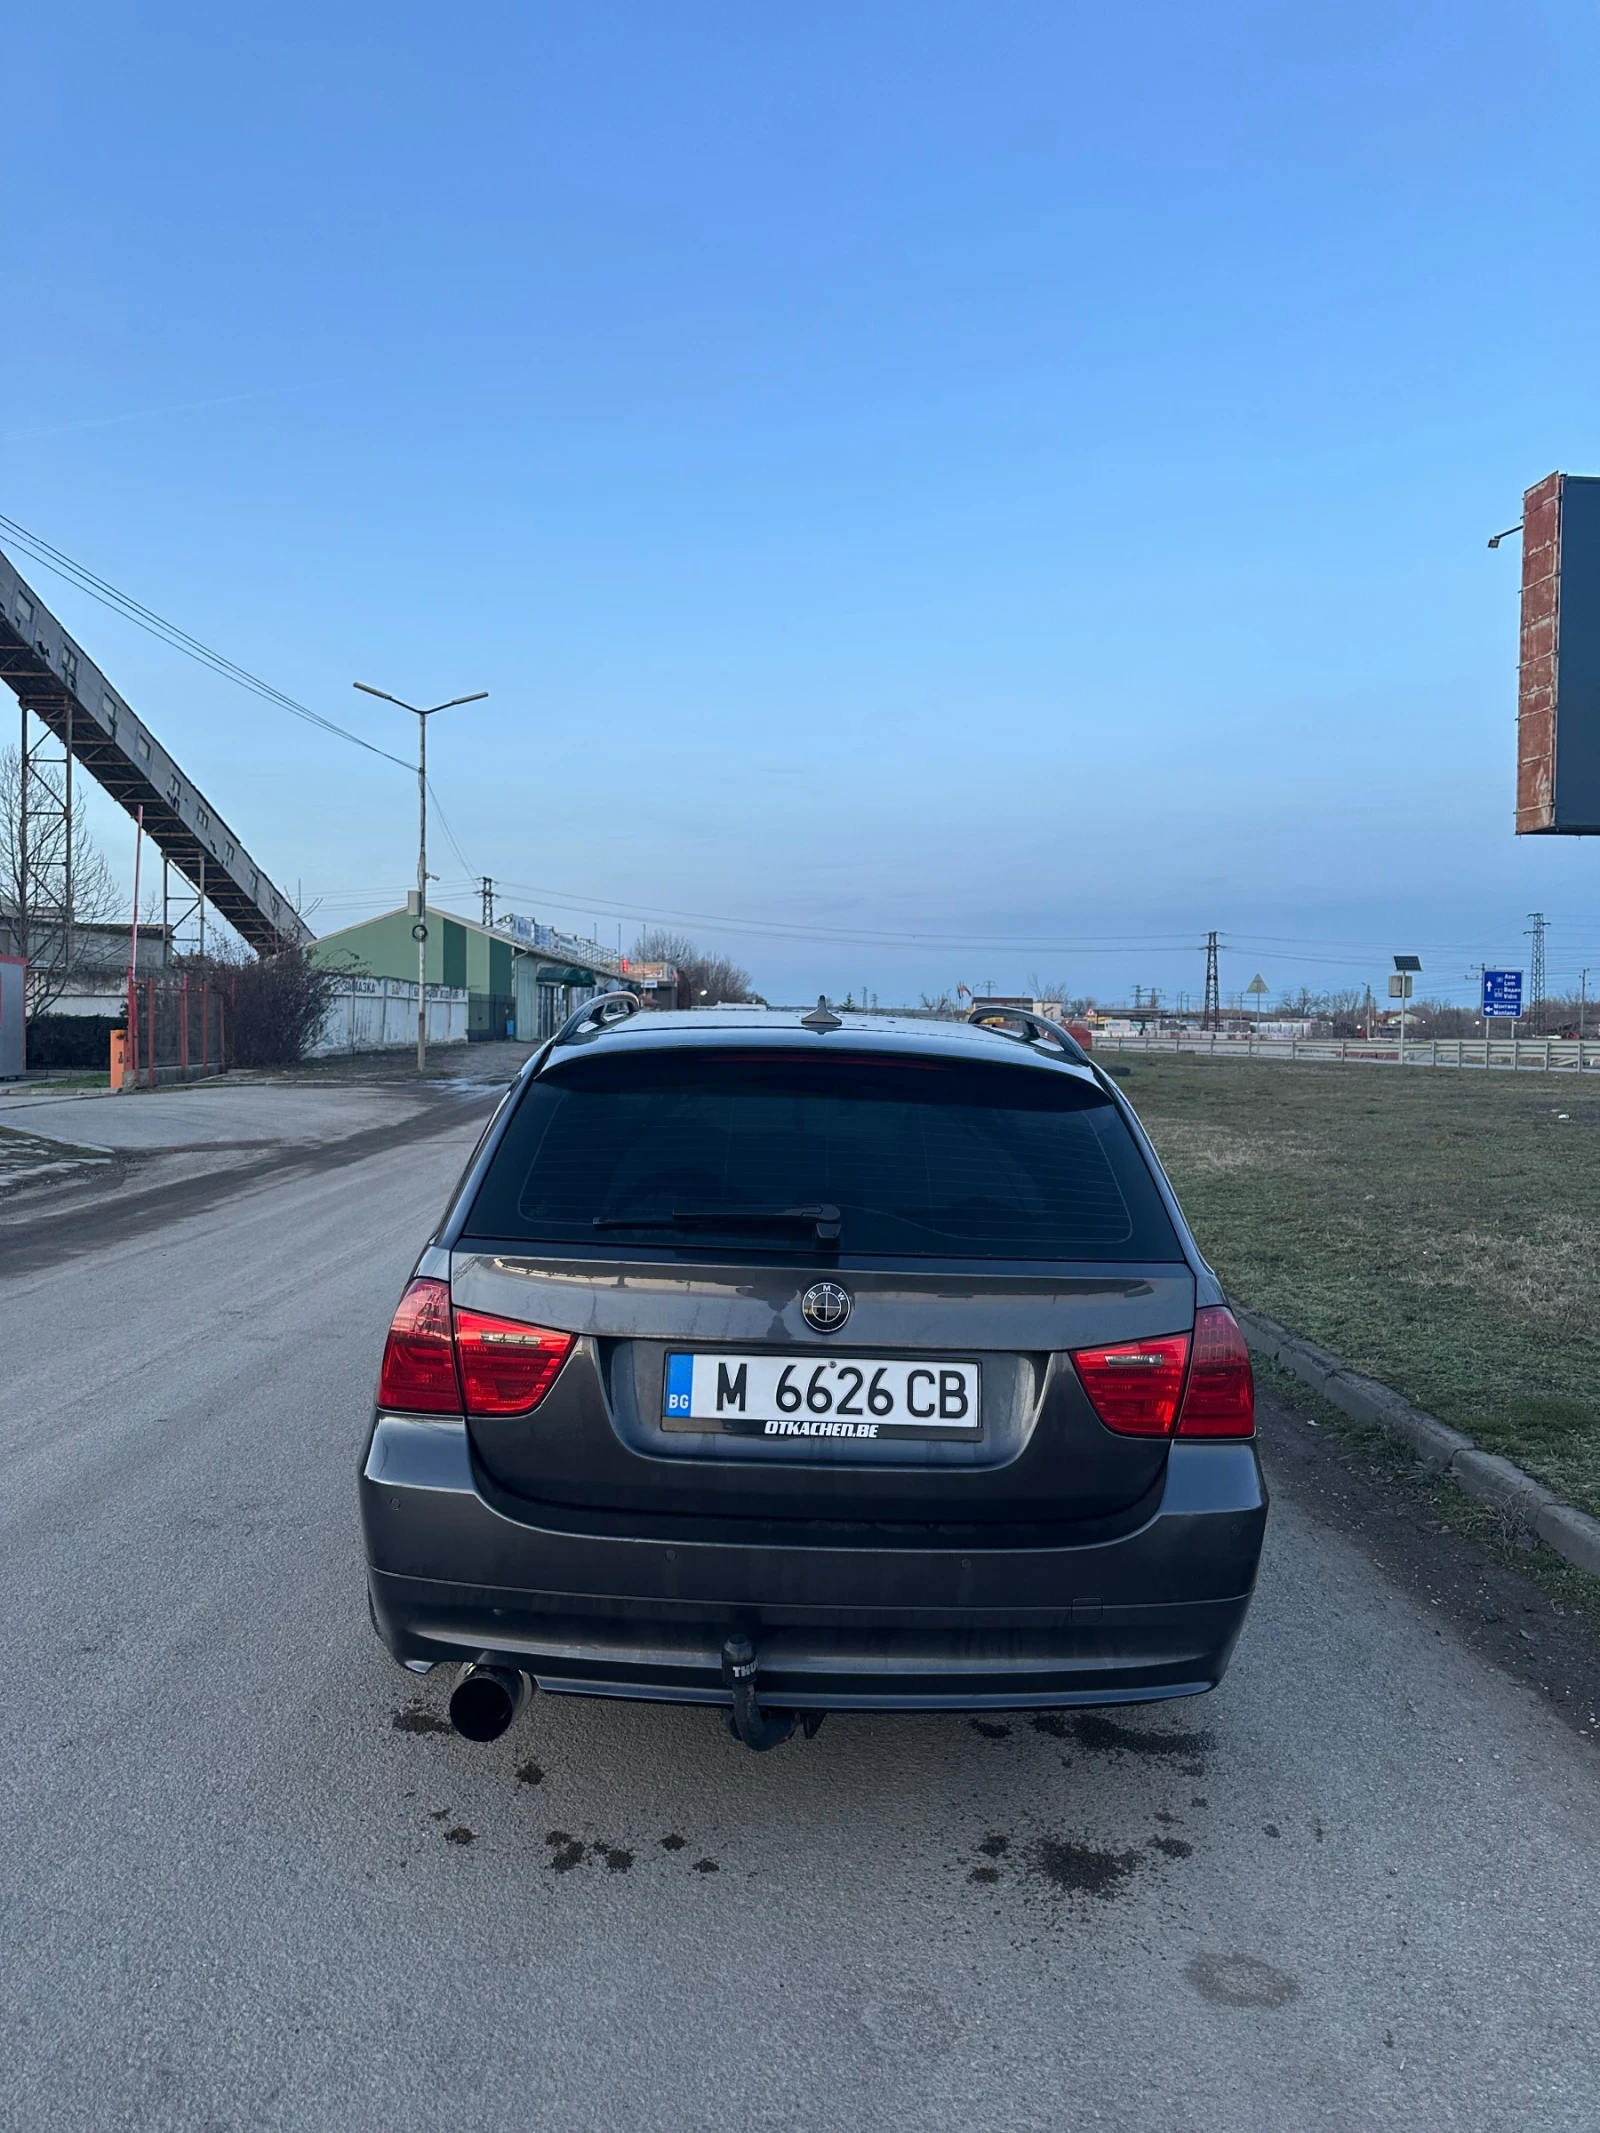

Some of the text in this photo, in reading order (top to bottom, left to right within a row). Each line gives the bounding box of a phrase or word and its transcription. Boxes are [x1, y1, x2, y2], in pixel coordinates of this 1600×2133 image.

[808, 1285, 846, 1301] BMW
[716, 1362, 969, 1419] M 6626 CB
[668, 1394, 689, 1409] BG
